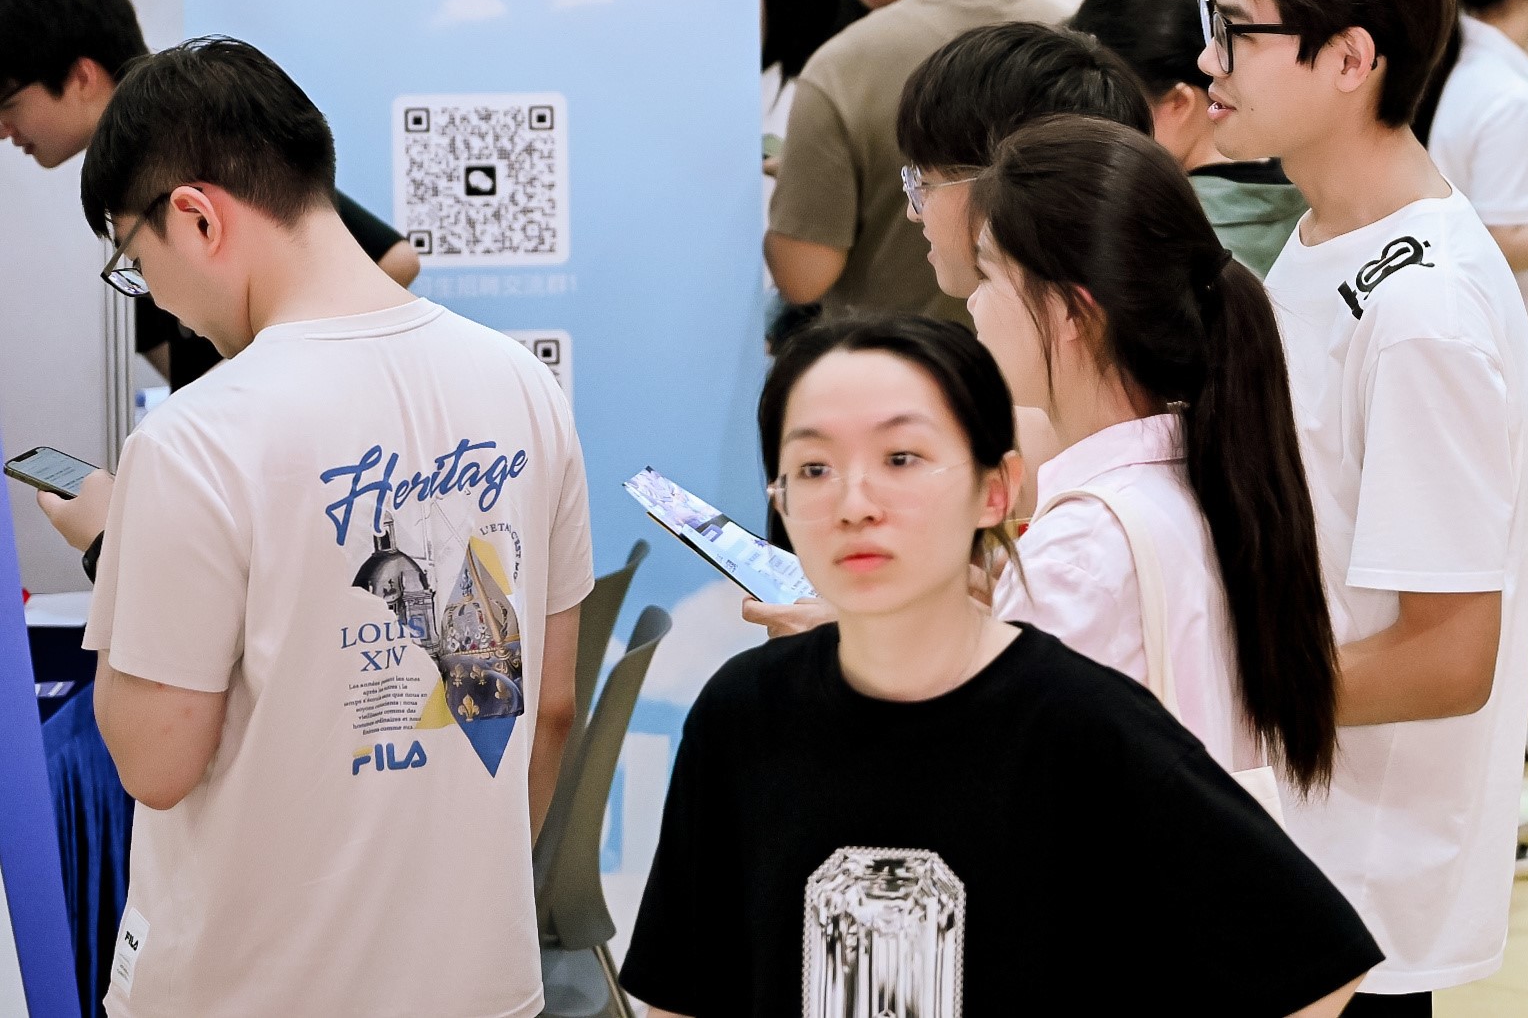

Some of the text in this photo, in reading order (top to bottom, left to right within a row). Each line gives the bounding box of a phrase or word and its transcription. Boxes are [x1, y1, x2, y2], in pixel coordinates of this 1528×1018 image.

[320, 438, 528, 546] Heritage
[340, 617, 426, 649] LOUIS
[360, 645, 407, 672] XIV
[352, 740, 427, 776] FILA
[124, 931, 140, 951] FILA
